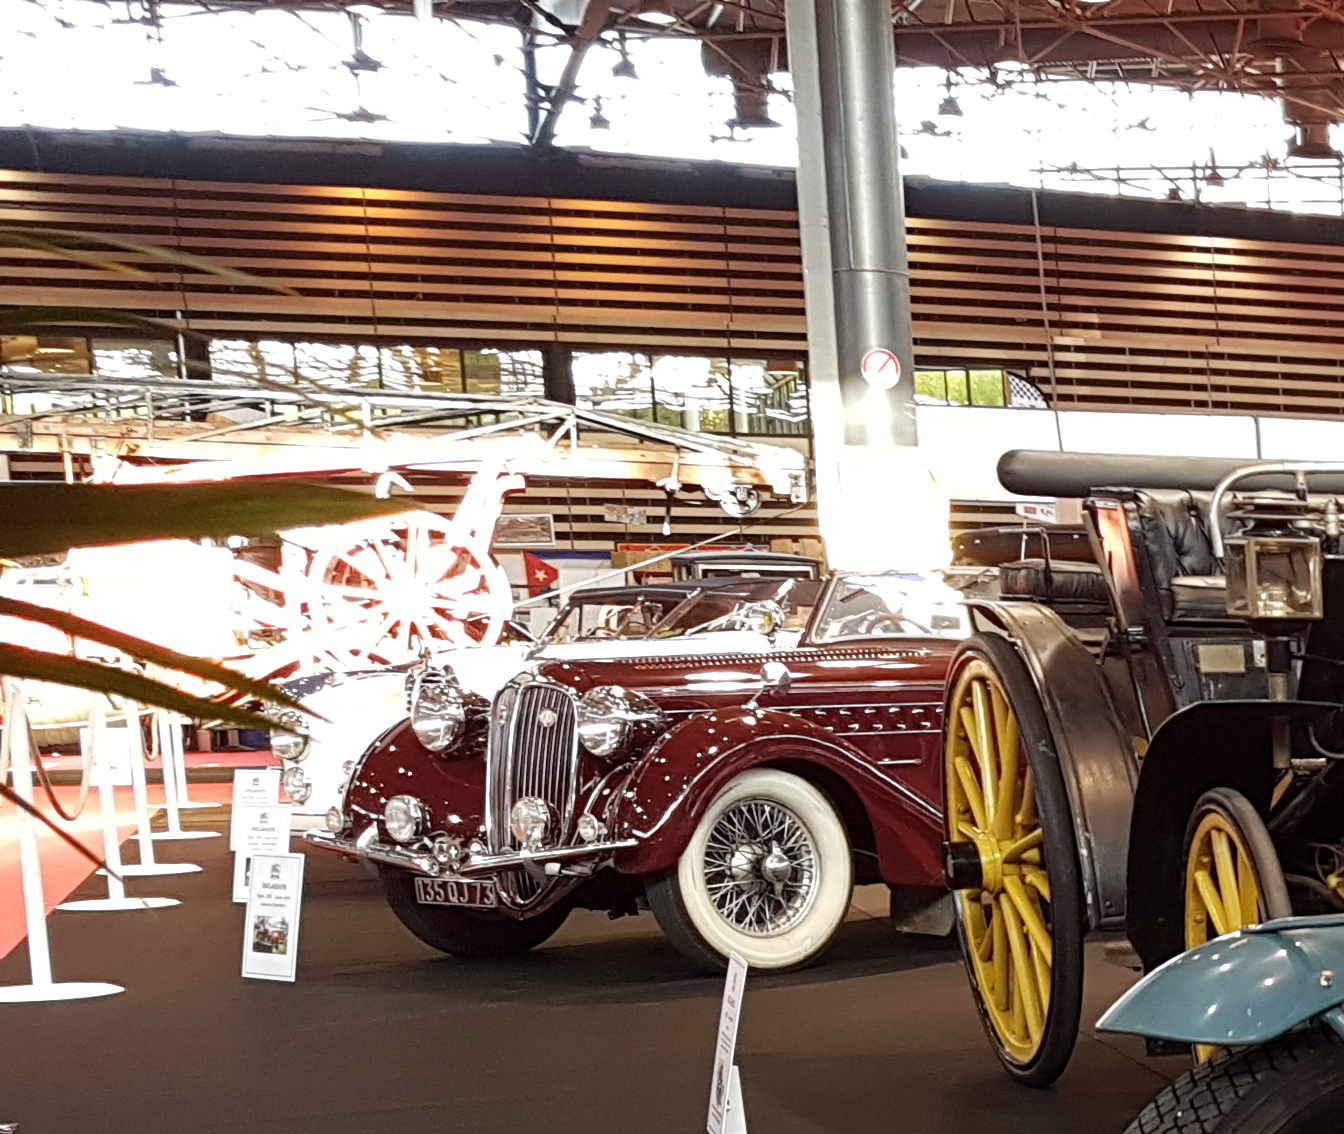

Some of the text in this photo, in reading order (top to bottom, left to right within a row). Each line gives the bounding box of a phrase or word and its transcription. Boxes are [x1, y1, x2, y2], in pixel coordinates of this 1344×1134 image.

[418, 879, 493, 905] 135 QJ 73
